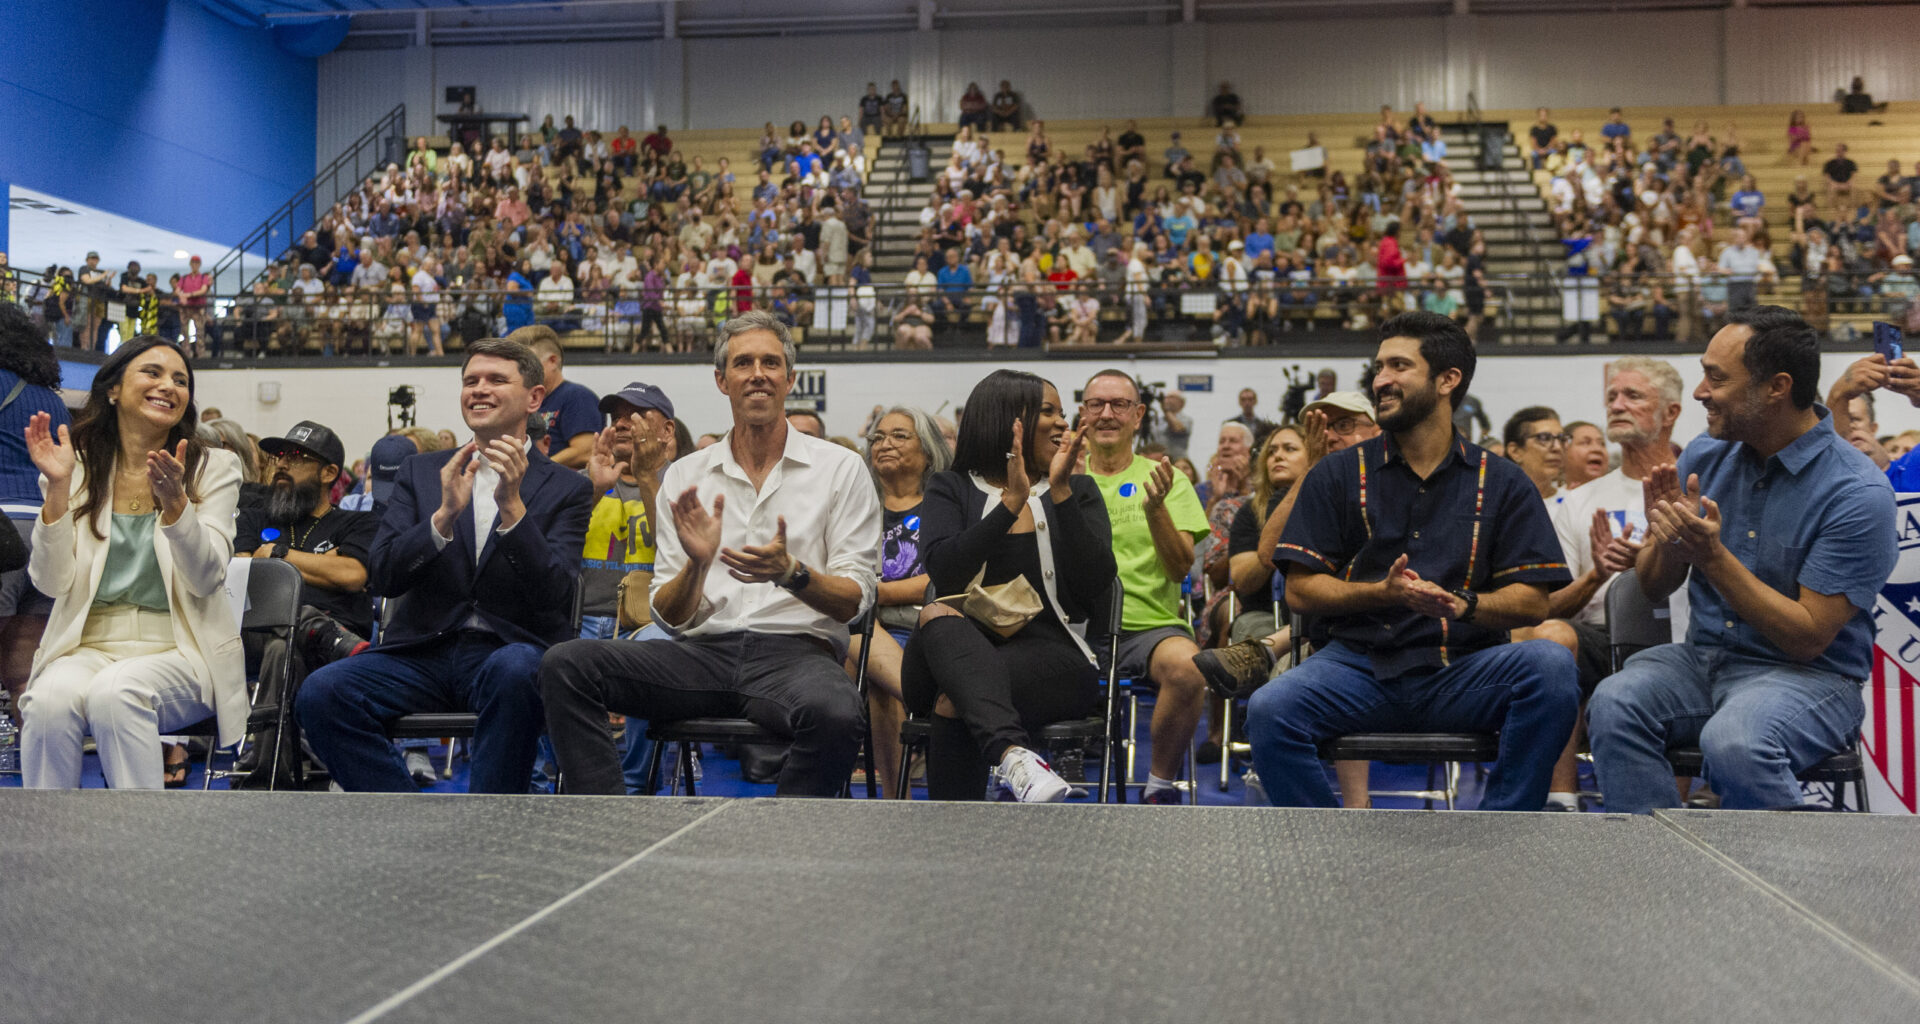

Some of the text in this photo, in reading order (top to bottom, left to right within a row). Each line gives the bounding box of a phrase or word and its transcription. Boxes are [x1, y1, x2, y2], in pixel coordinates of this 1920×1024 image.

[790, 372, 823, 394] XIT
[1120, 503, 1136, 516] just
[1111, 513, 1130, 526] onut
